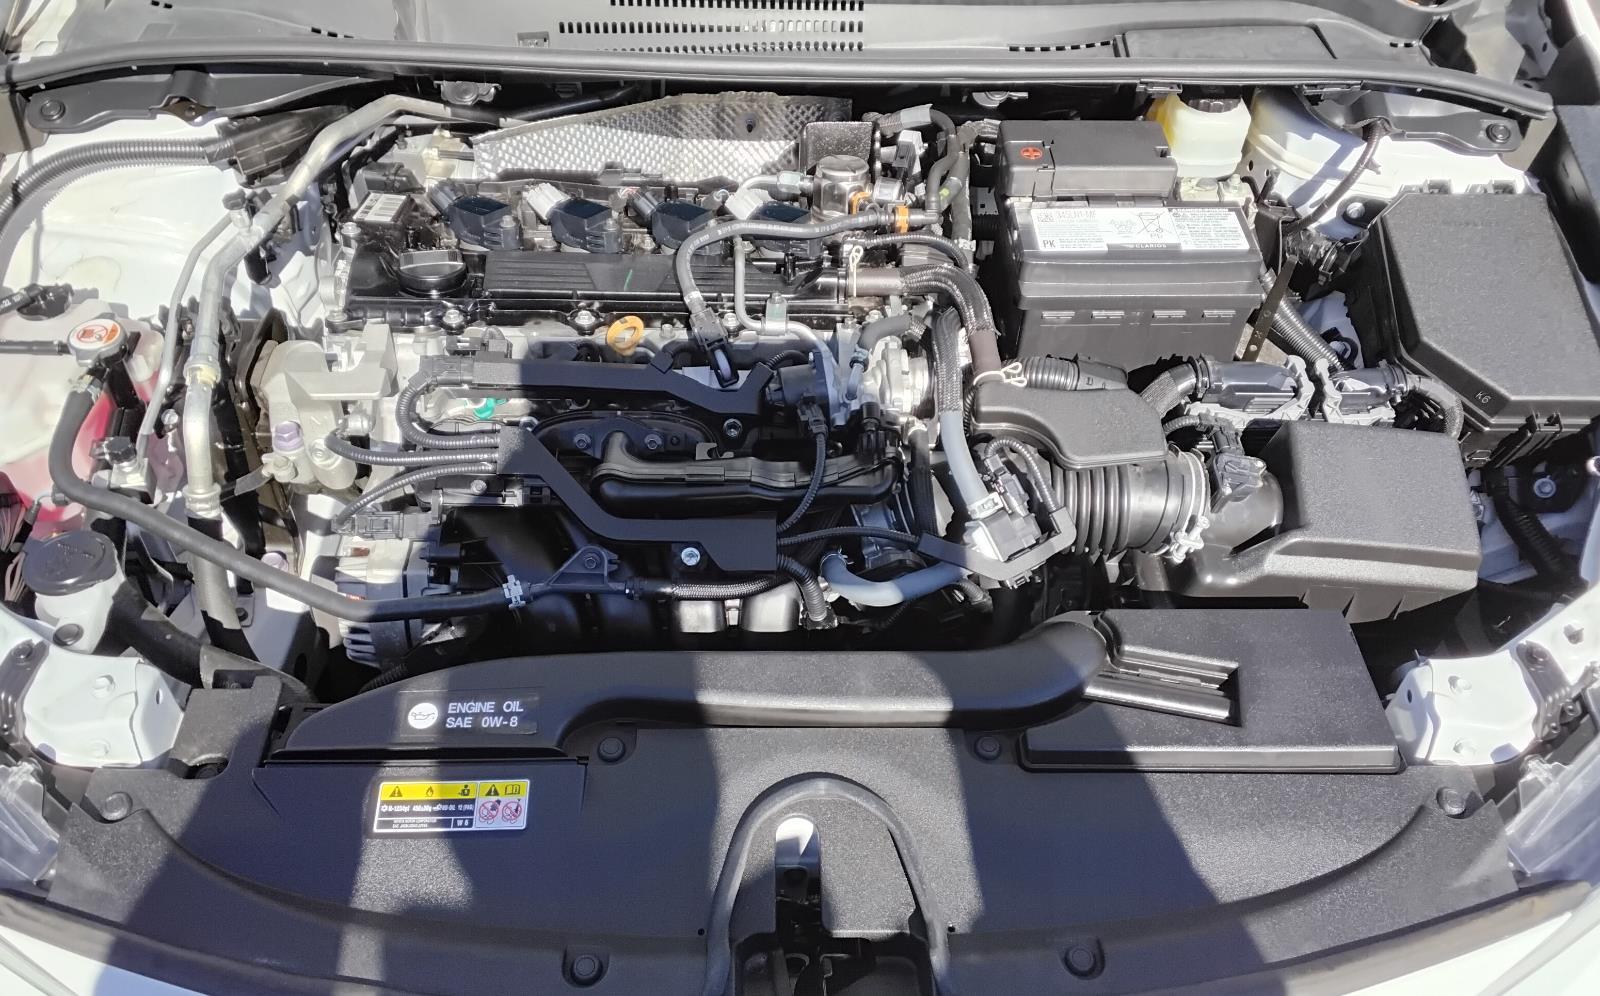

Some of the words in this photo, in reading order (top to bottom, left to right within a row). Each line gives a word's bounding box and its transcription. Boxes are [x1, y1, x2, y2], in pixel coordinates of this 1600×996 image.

[1042, 239, 1056, 249] PK
[1474, 390, 1492, 404] K6
[447, 701, 496, 714] ENGINE
[502, 700, 524, 712] OIL
[445, 716, 473, 728] SAE
[481, 715, 519, 728] 0W-8
